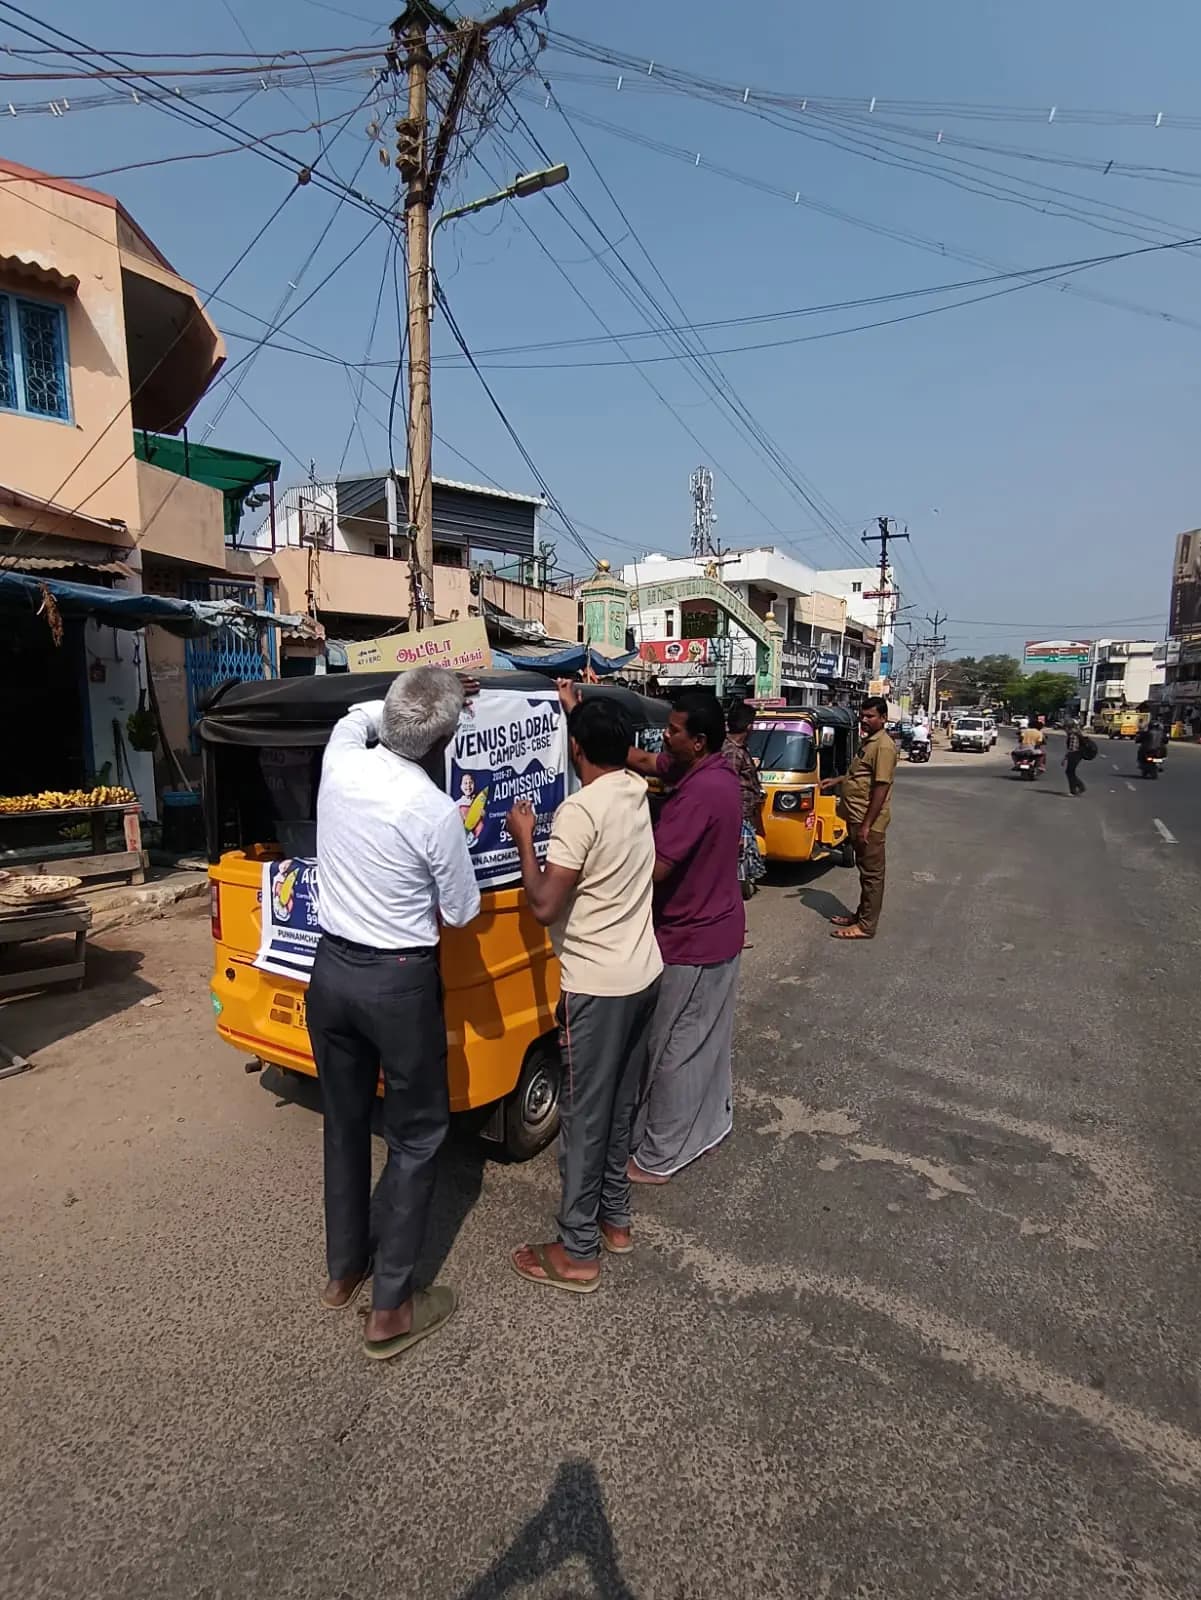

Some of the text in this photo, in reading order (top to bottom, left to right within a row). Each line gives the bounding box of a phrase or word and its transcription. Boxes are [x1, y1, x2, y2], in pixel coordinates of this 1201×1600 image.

[397, 639, 451, 663] ஆட்டோ
[455, 712, 559, 760] VENUS GLOBAL
[489, 742, 526, 767] CAMPUS
[531, 735, 551, 752] CBSE
[493, 768, 556, 802] ADMISSIONS
